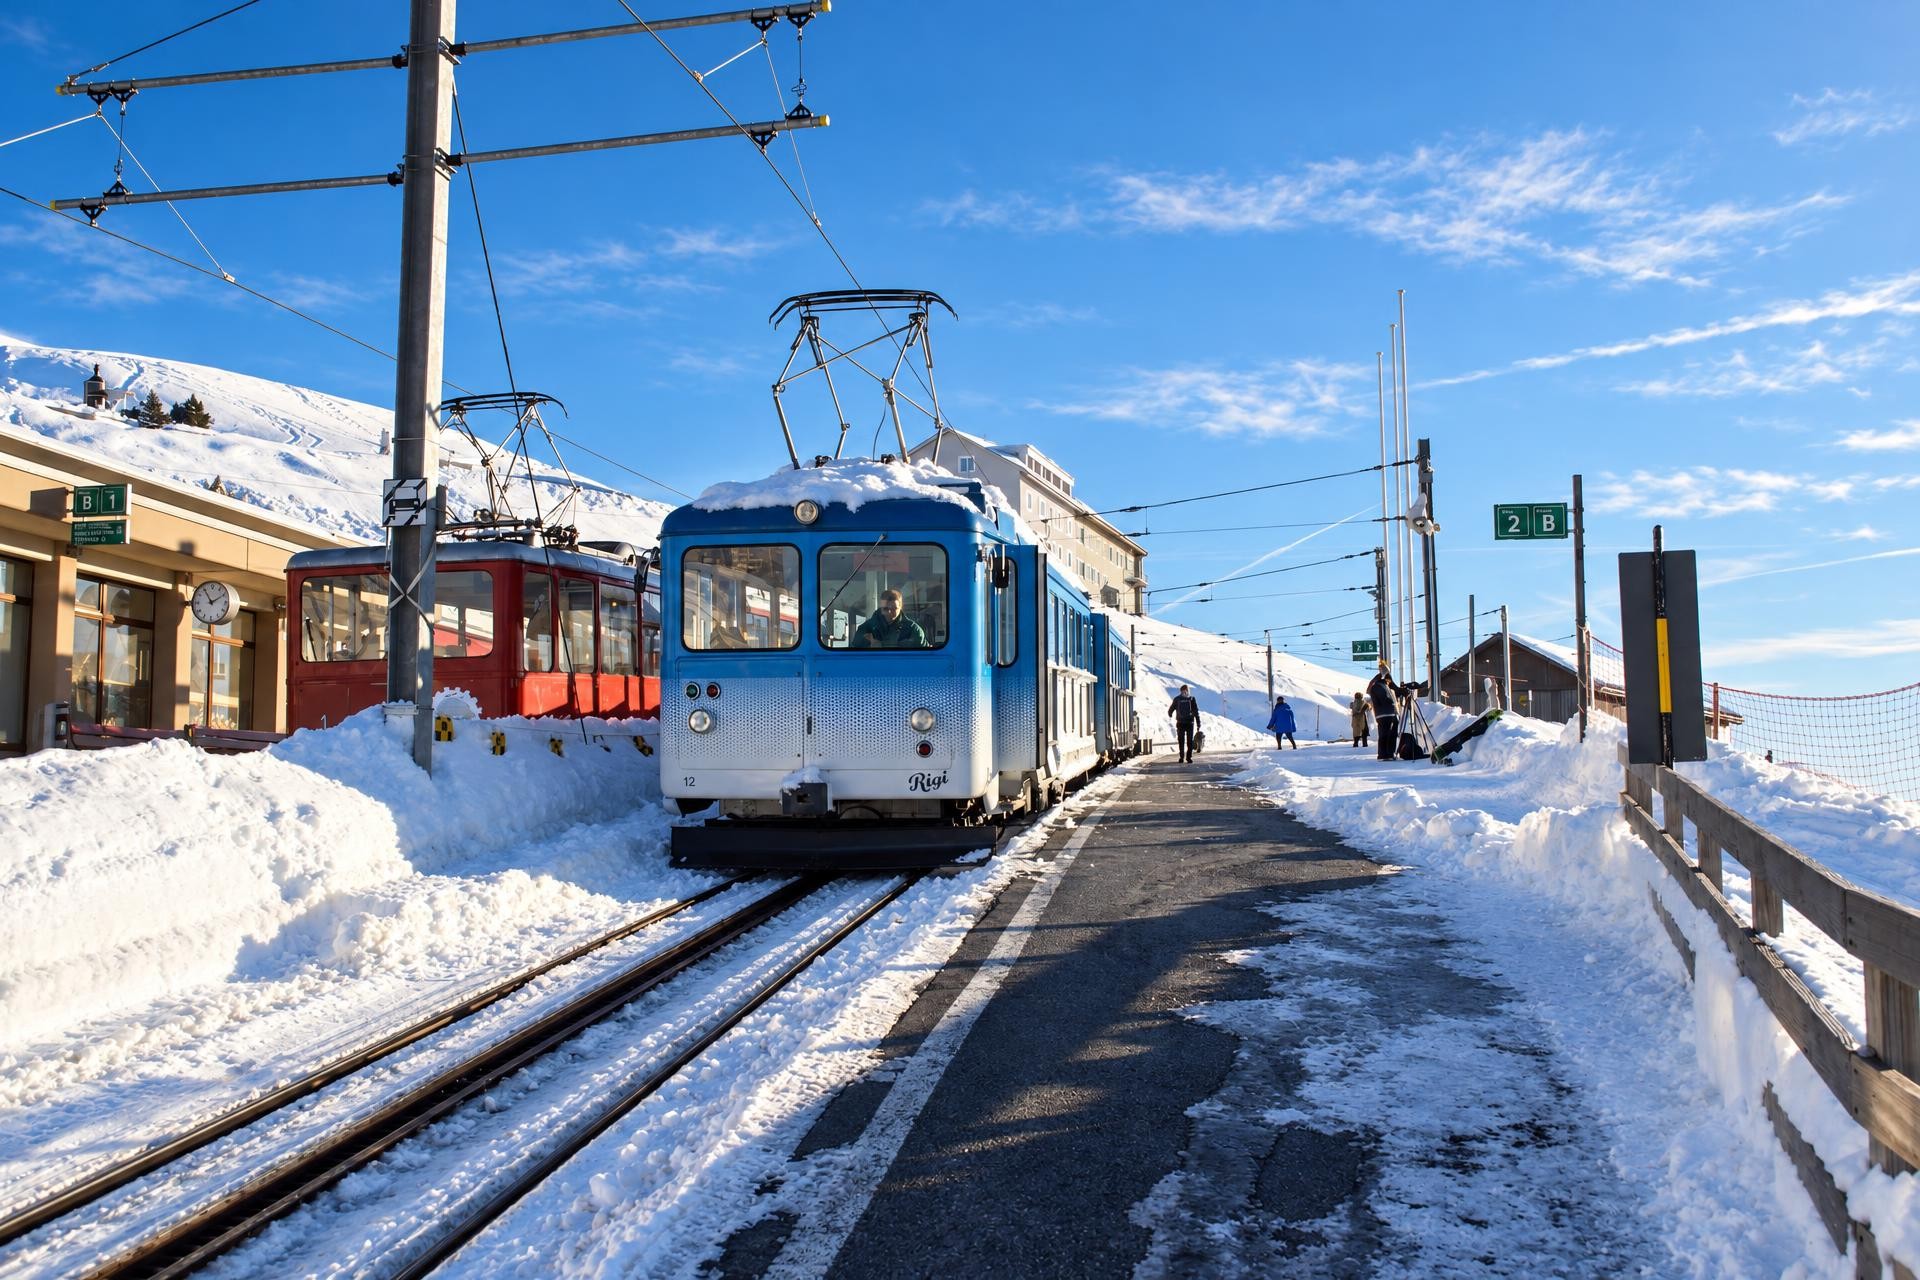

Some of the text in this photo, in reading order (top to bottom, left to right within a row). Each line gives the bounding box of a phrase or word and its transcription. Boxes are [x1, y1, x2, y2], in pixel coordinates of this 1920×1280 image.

[82, 494, 115, 510] B 1
[1508, 514, 1555, 533] 2 B
[683, 776, 696, 787] 12
[908, 770, 949, 793] Rigi
